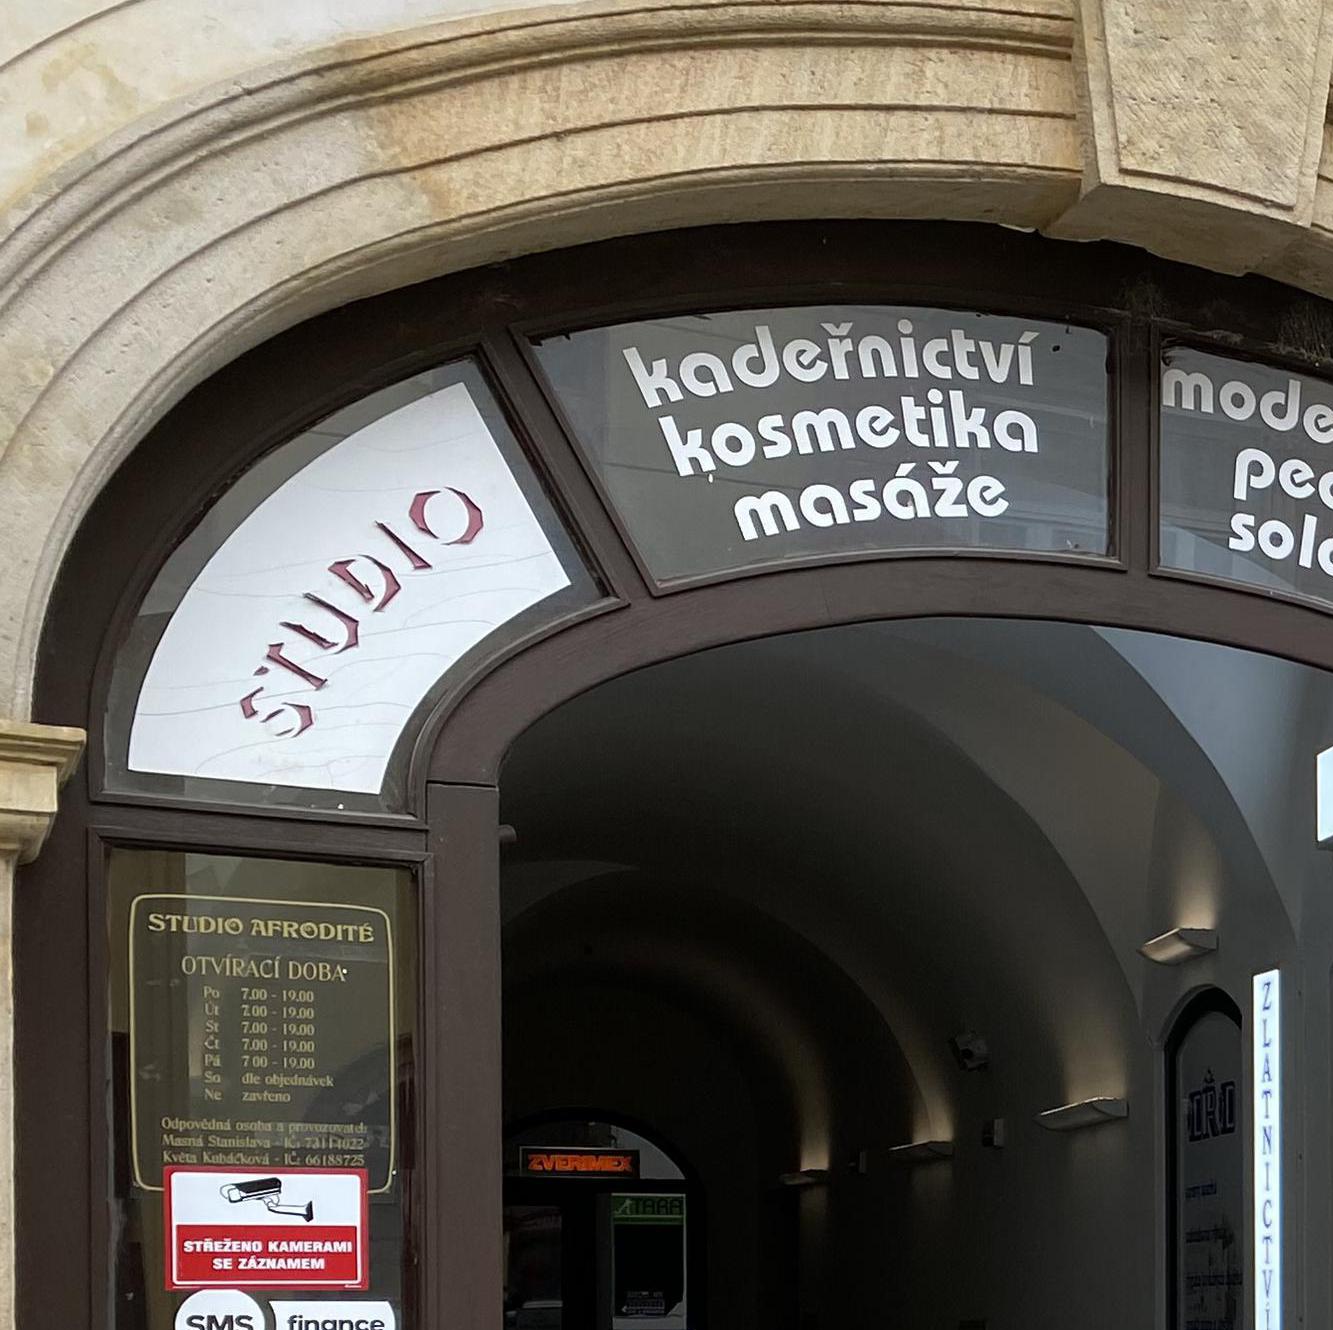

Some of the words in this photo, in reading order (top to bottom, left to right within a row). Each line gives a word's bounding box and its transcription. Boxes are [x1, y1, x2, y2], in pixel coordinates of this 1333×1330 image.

[622, 320, 1039, 409] kadeřnictví
[657, 389, 1039, 477] kosmetika
[733, 460, 1009, 541] masáže
[240, 486, 484, 737] STUDIO
[148, 913, 243, 935] STUDIO
[251, 918, 375, 942] AFRODITÉ
[182, 954, 280, 979] OTVÍRACÍ
[288, 961, 346, 982] DOBA
[203, 986, 220, 998] Po
[241, 987, 267, 1000] 7.00
[282, 990, 314, 1002] 19.00
[282, 1006, 314, 1019] 19.00
[241, 1021, 268, 1034] 7.00
[283, 1023, 315, 1036] 19.00
[283, 1040, 315, 1053] 19.00
[283, 1057, 315, 1069] 19.00
[241, 1072, 260, 1085] dle
[183, 1237, 263, 1253] STŘEŽENO
[268, 1240, 352, 1253] KAMERAMI
[212, 1258, 233, 1270] SE
[238, 1255, 325, 1270] ZÁZNAMEM
